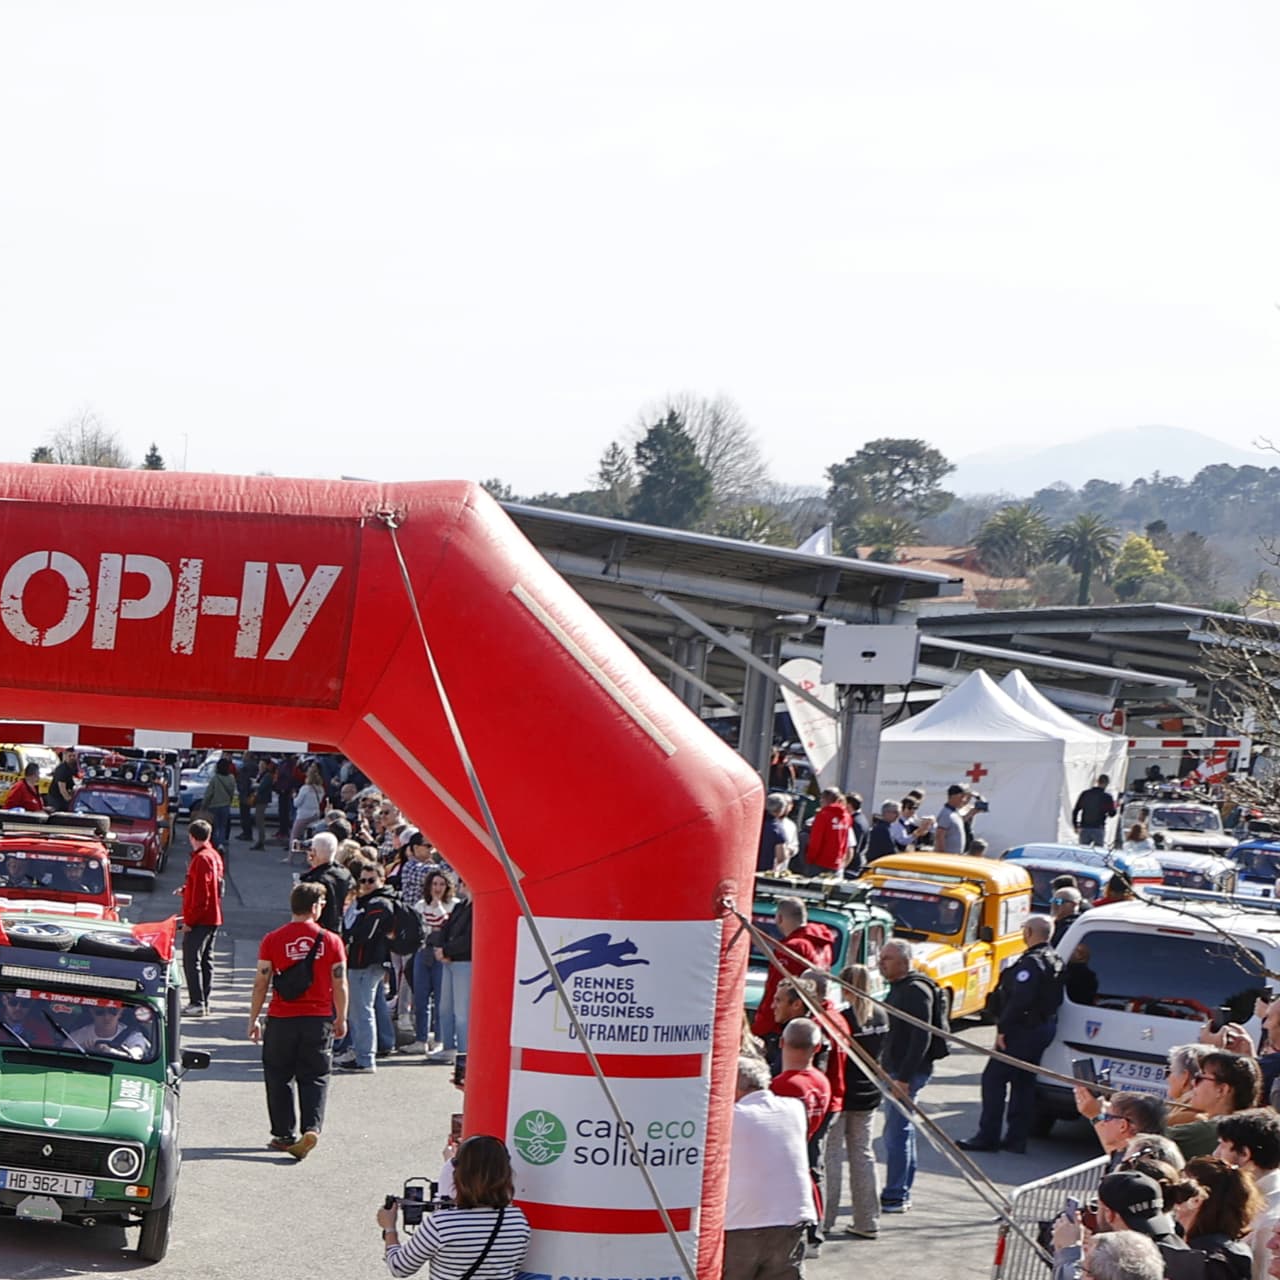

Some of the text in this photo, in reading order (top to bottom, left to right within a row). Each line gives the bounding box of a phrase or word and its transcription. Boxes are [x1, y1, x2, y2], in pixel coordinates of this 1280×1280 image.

[574, 976, 635, 990] RENNES
[572, 990, 638, 1005] SCHOOL
[580, 1004, 655, 1018] BUSINESS
[652, 1023, 710, 1042] THINKING
[576, 1119, 696, 1148] cap eco
[573, 1142, 699, 1167] solidaire
[9, 1173, 83, 1194] HB-962-LT
